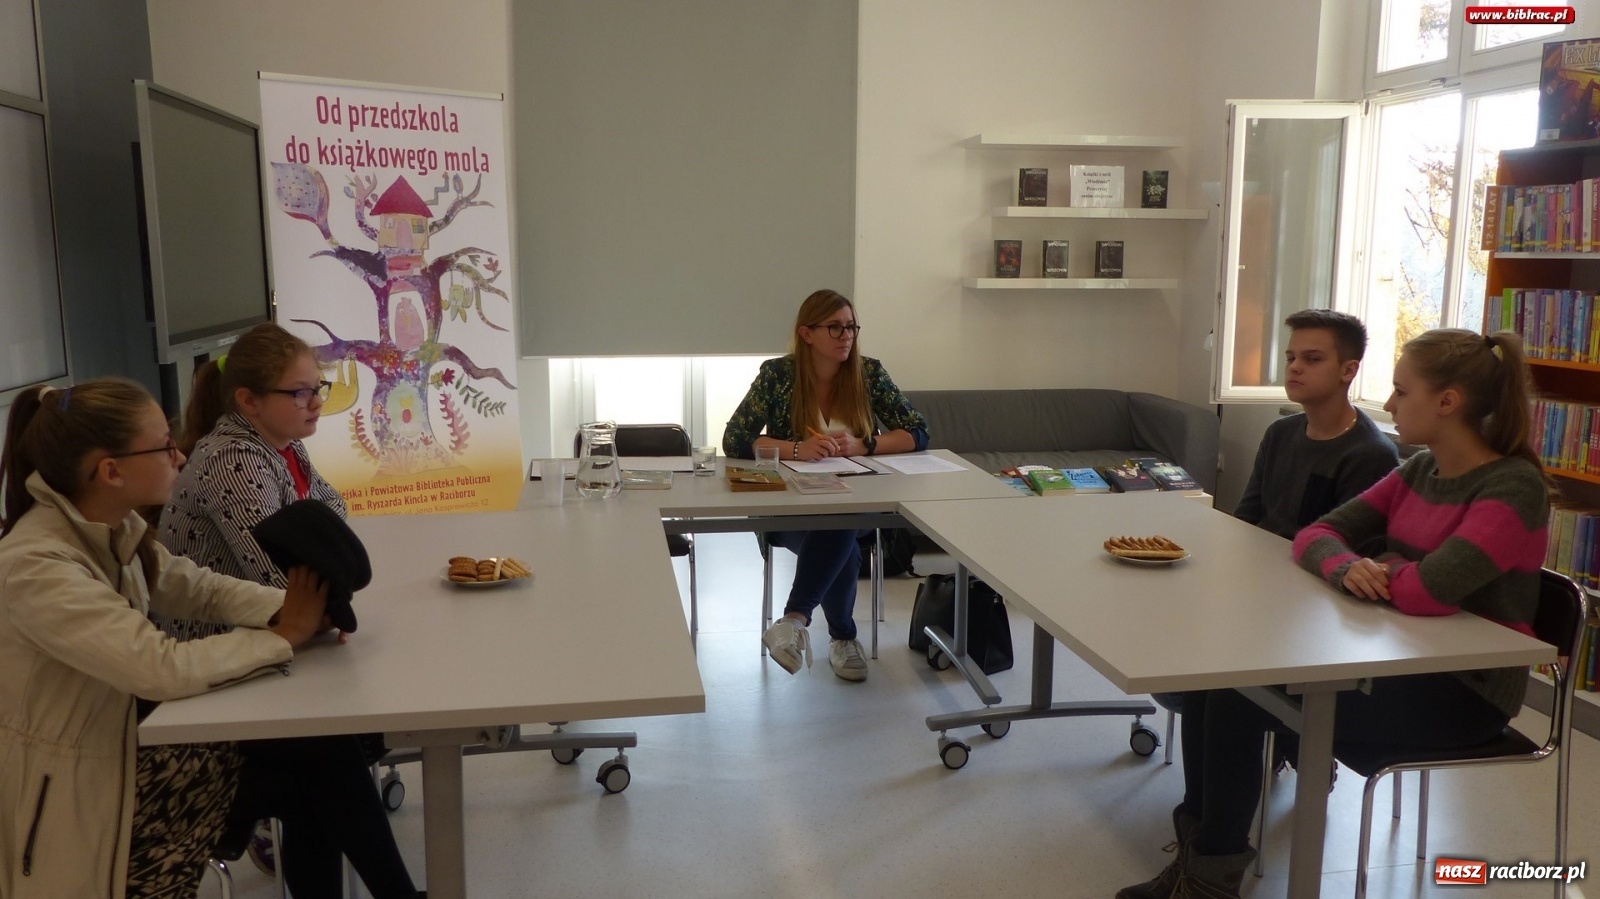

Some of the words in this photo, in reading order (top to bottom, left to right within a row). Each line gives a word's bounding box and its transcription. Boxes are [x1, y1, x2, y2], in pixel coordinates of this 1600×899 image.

[316, 95, 342, 126] Od
[348, 101, 460, 133] przedszkola
[285, 135, 310, 164] do
[316, 137, 438, 175] książkowego
[444, 146, 490, 173] mola
[339, 488, 363, 501] iejska
[370, 484, 414, 497] Powiatowa
[416, 478, 455, 491] Biblioteka
[456, 475, 491, 487] Publiczna
[351, 502, 365, 512] im.
[367, 497, 402, 511] Ryszarda
[404, 494, 428, 506] Kincla
[430, 494, 438, 502] w
[440, 489, 476, 501] Raciborzu
